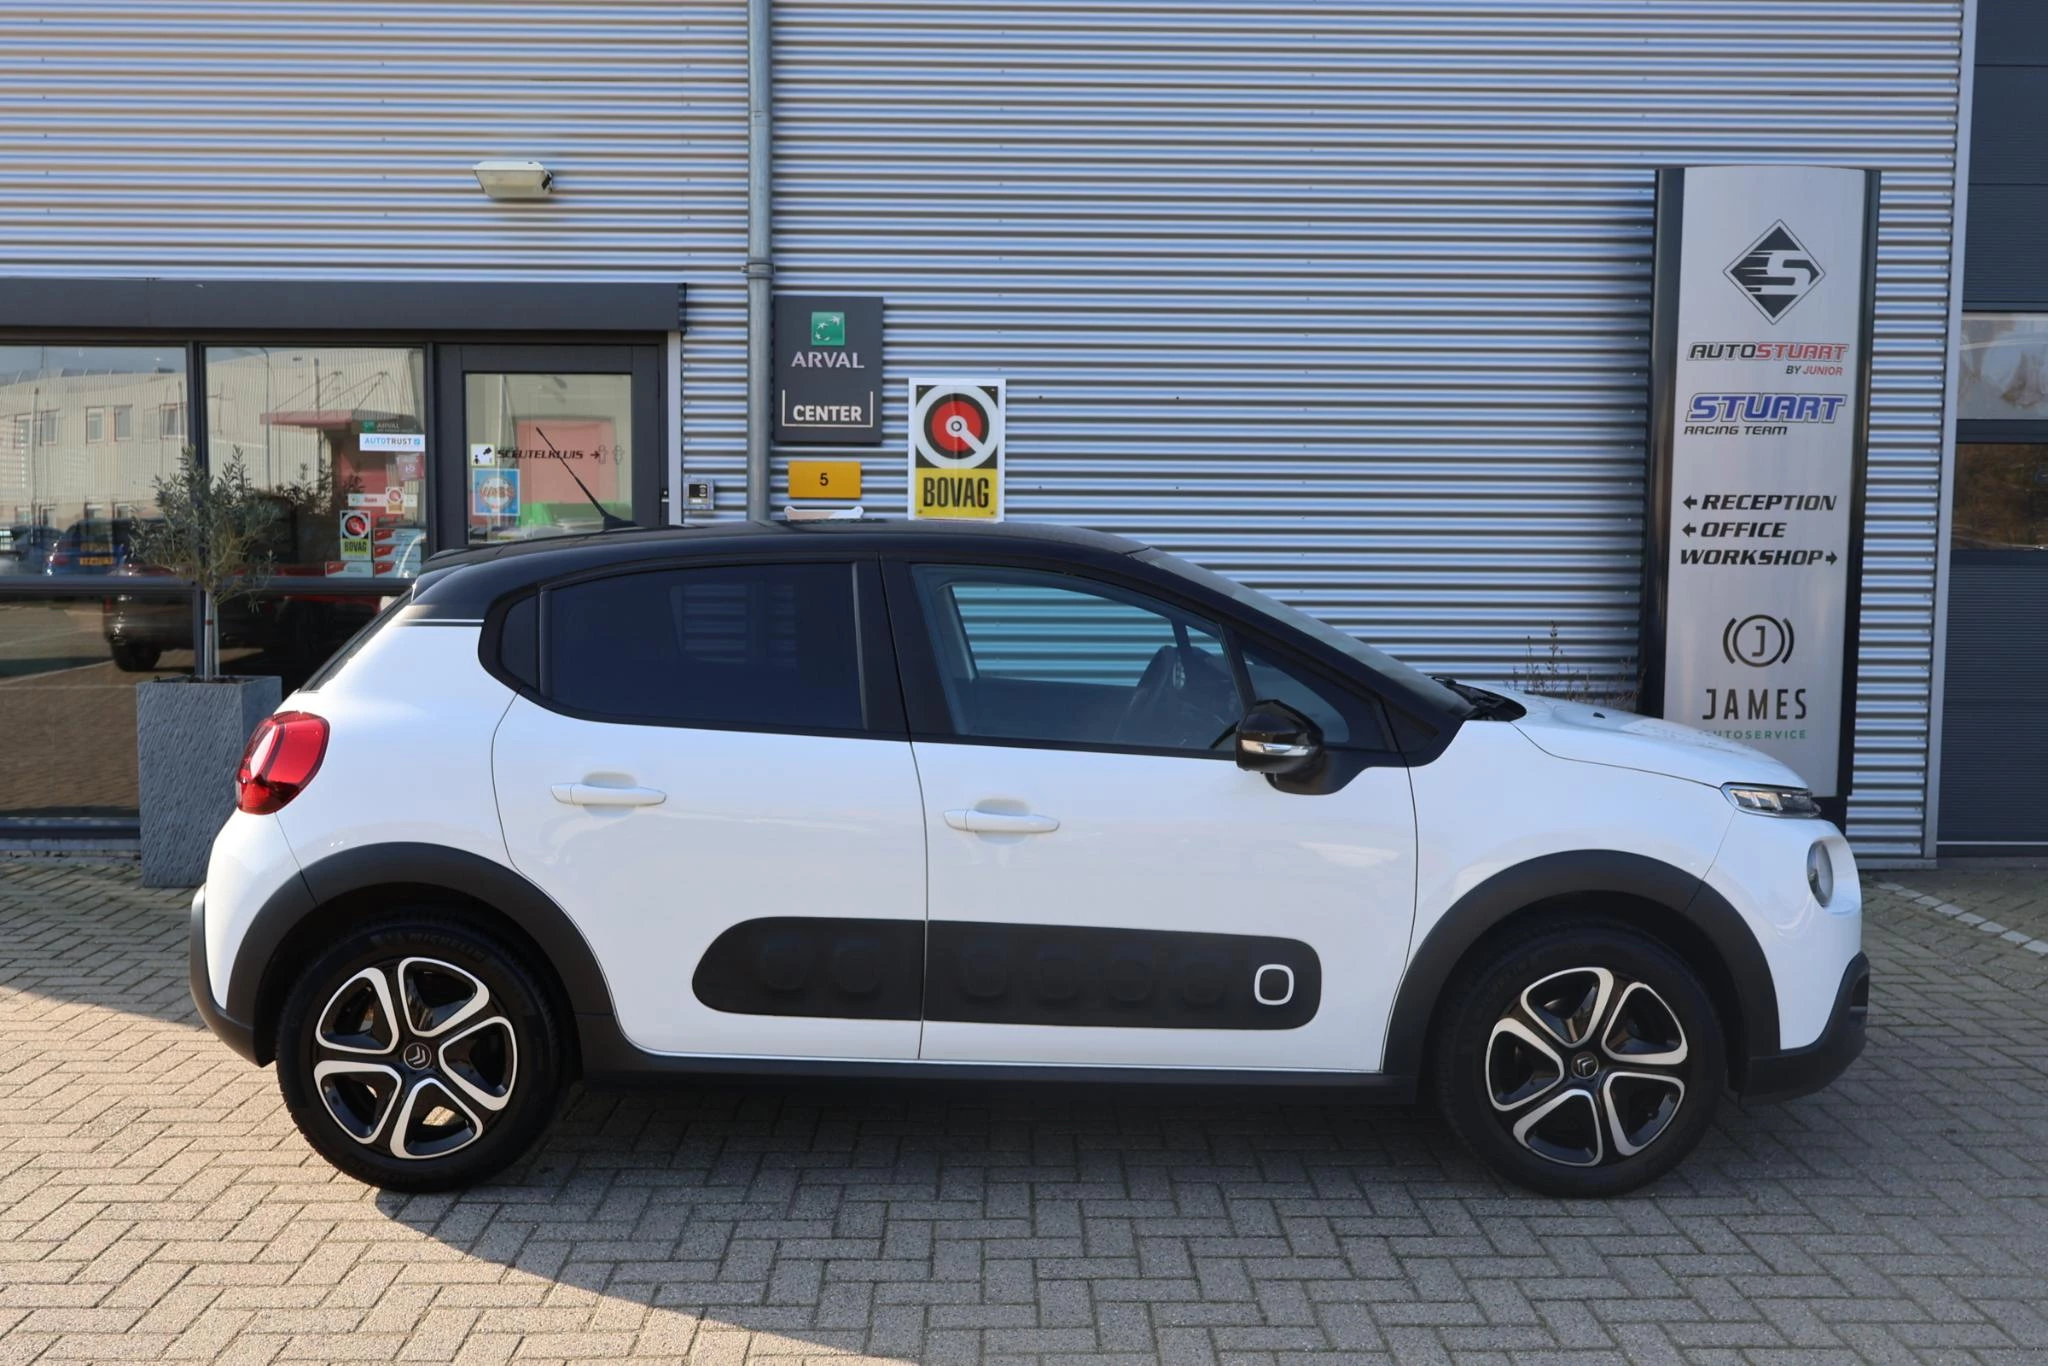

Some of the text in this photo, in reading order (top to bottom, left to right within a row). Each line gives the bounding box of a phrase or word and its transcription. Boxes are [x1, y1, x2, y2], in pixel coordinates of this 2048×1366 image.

[1688, 342, 1848, 361] AUTOSTUART
[791, 352, 865, 369] ARVAL
[1785, 365, 1843, 376] BY JUNIOR
[793, 405, 863, 422] CENTER
[1686, 392, 1848, 423] STUART
[1684, 425, 1788, 436] RACING TEAM
[364, 437, 412, 446] AUTOTRUST
[819, 472, 829, 487] 5
[923, 477, 989, 508] BOVAG
[1701, 494, 1838, 511] RECEPTION
[1700, 522, 1787, 538] OFFICE
[1680, 549, 1823, 566] WORKSHOP
[1702, 688, 1807, 720] JAMES
[1703, 729, 1807, 741] UTOSERVICE
